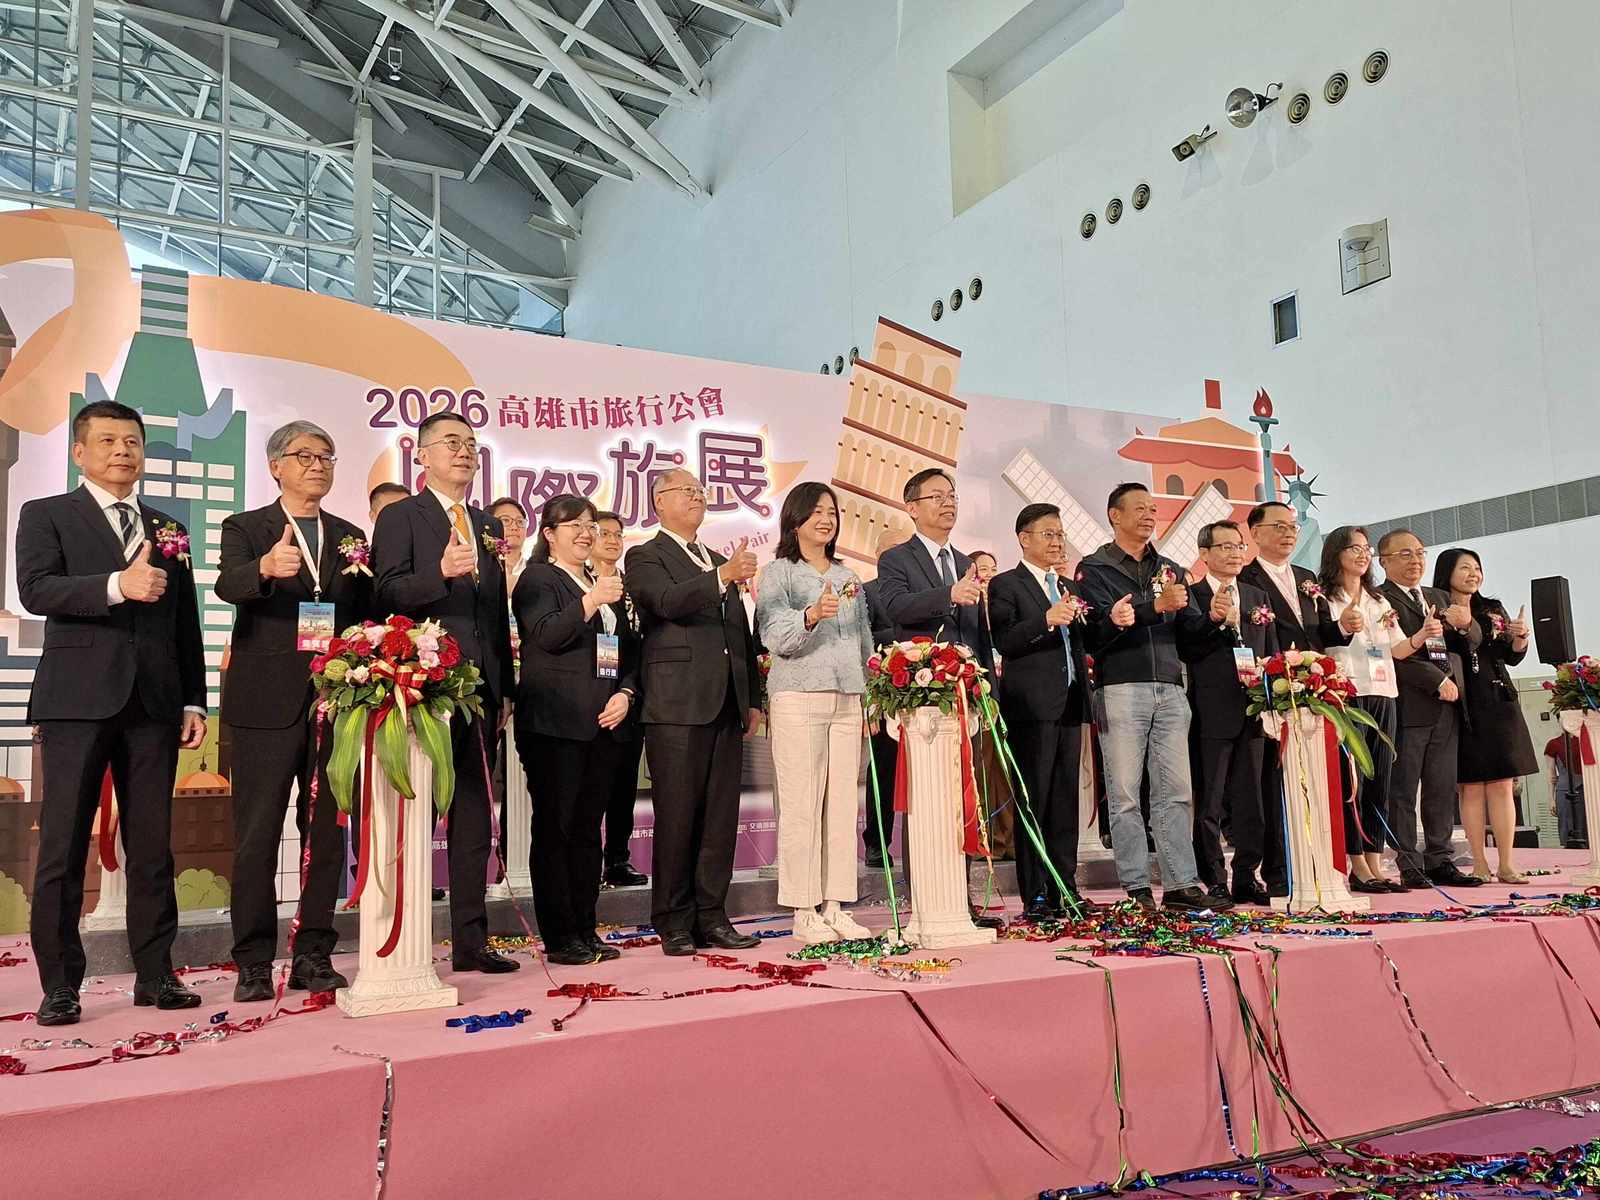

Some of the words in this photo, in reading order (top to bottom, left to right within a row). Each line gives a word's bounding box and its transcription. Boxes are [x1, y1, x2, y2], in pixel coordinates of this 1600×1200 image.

[366, 388, 489, 428] 2026
[496, 386, 725, 430] 高雄市旅行公會
